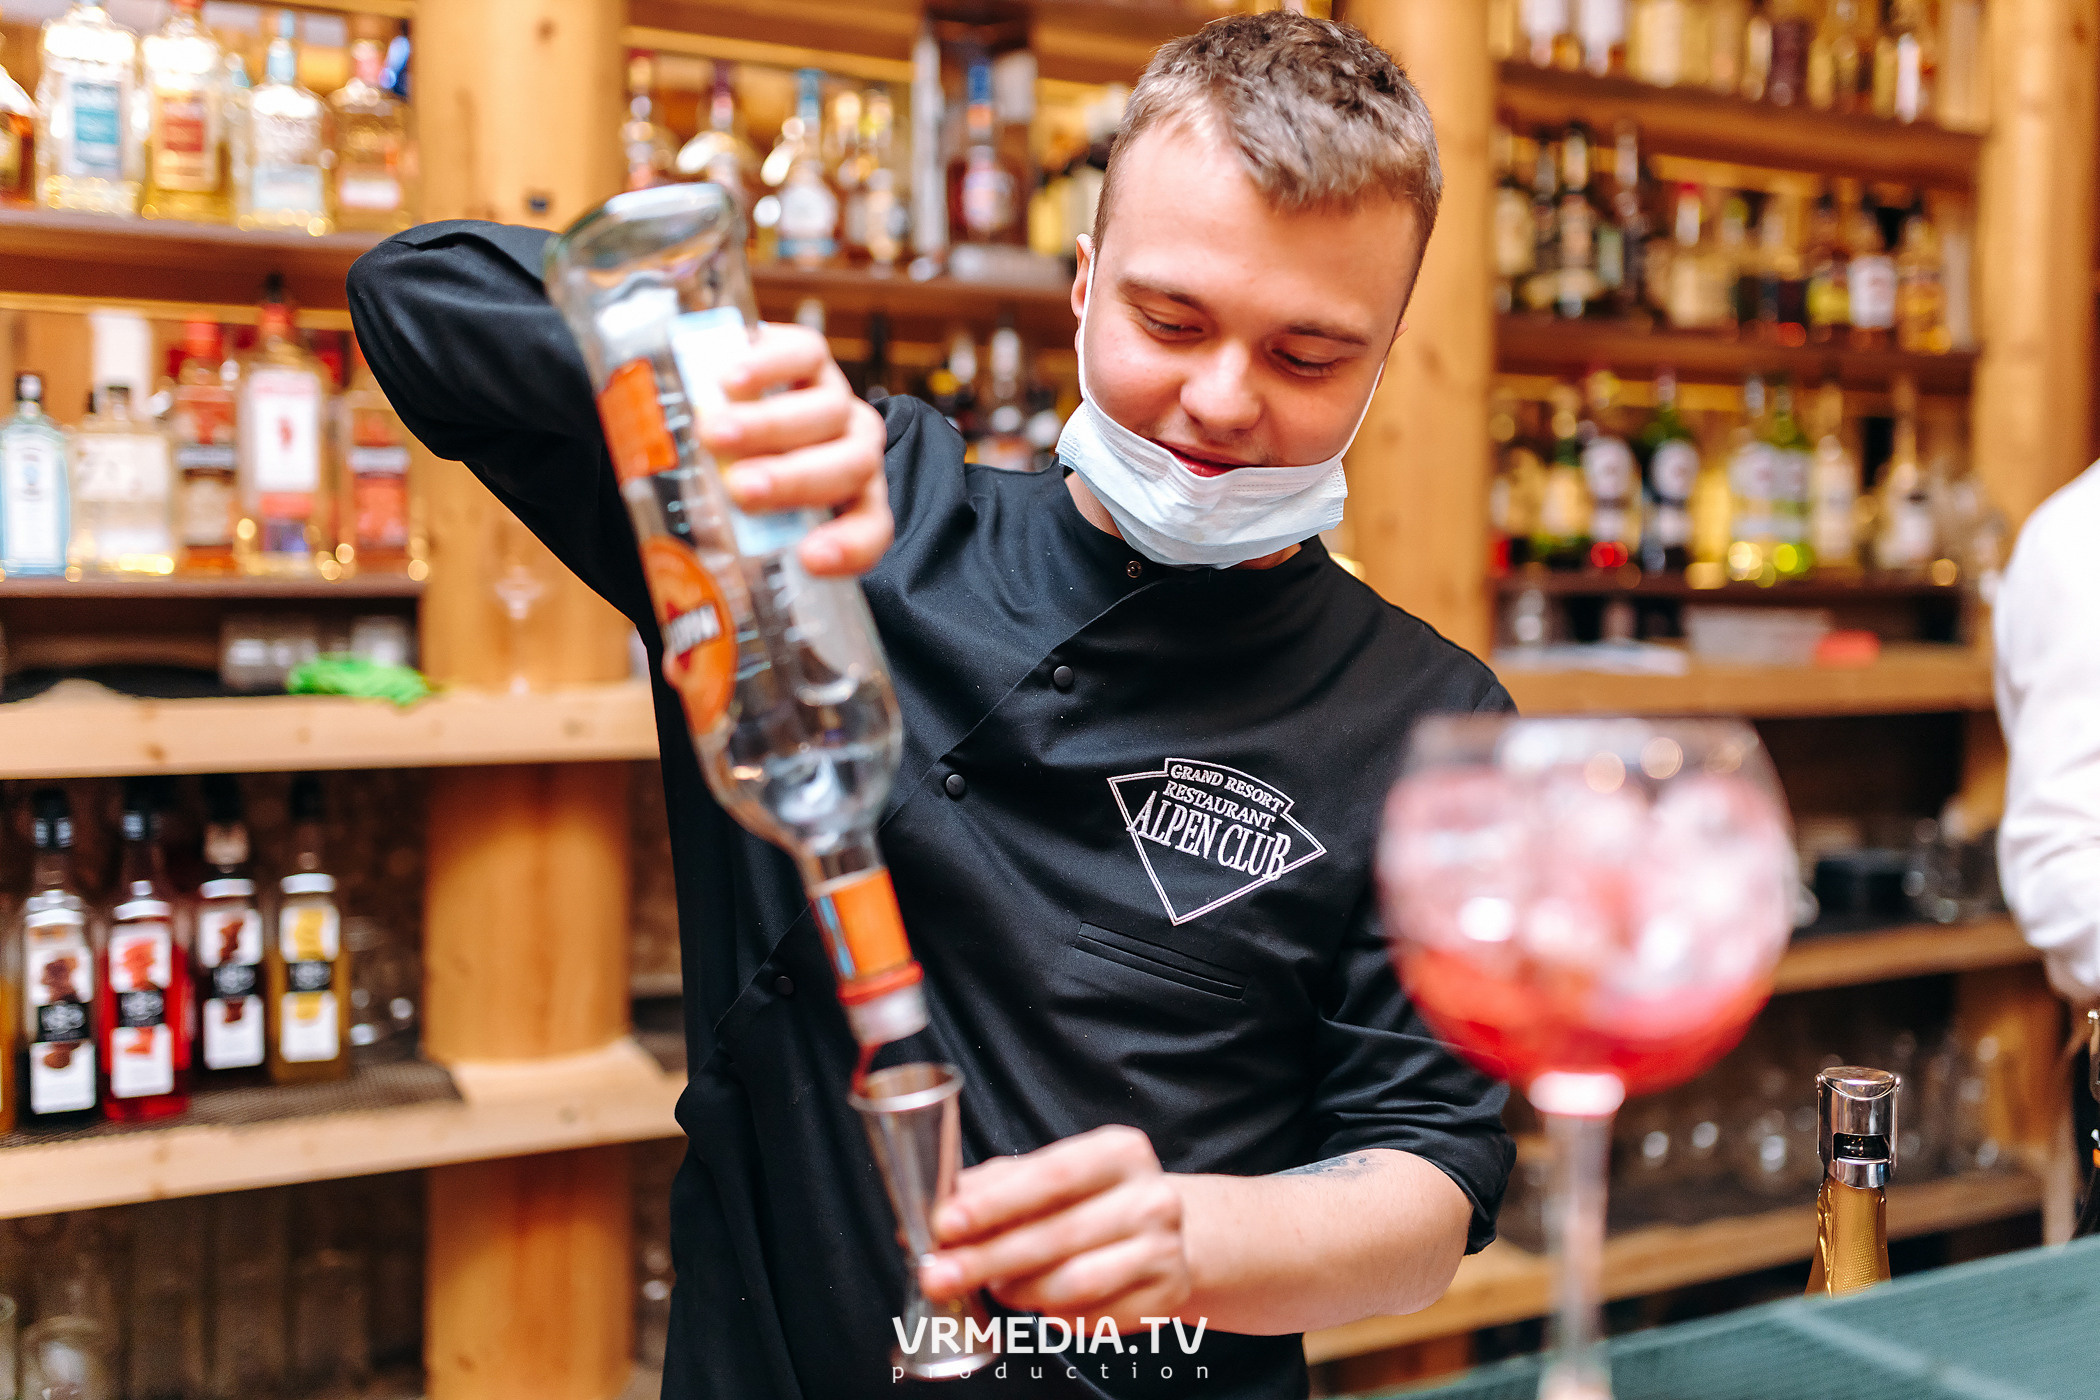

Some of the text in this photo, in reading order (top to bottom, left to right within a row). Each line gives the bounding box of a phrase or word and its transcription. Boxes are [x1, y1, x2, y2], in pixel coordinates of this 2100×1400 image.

[1162, 780, 1276, 832] RESTAURANT
[1170, 764, 1286, 814] GRAND RESORT
[1126, 790, 1292, 881] ALPEN CLUB
